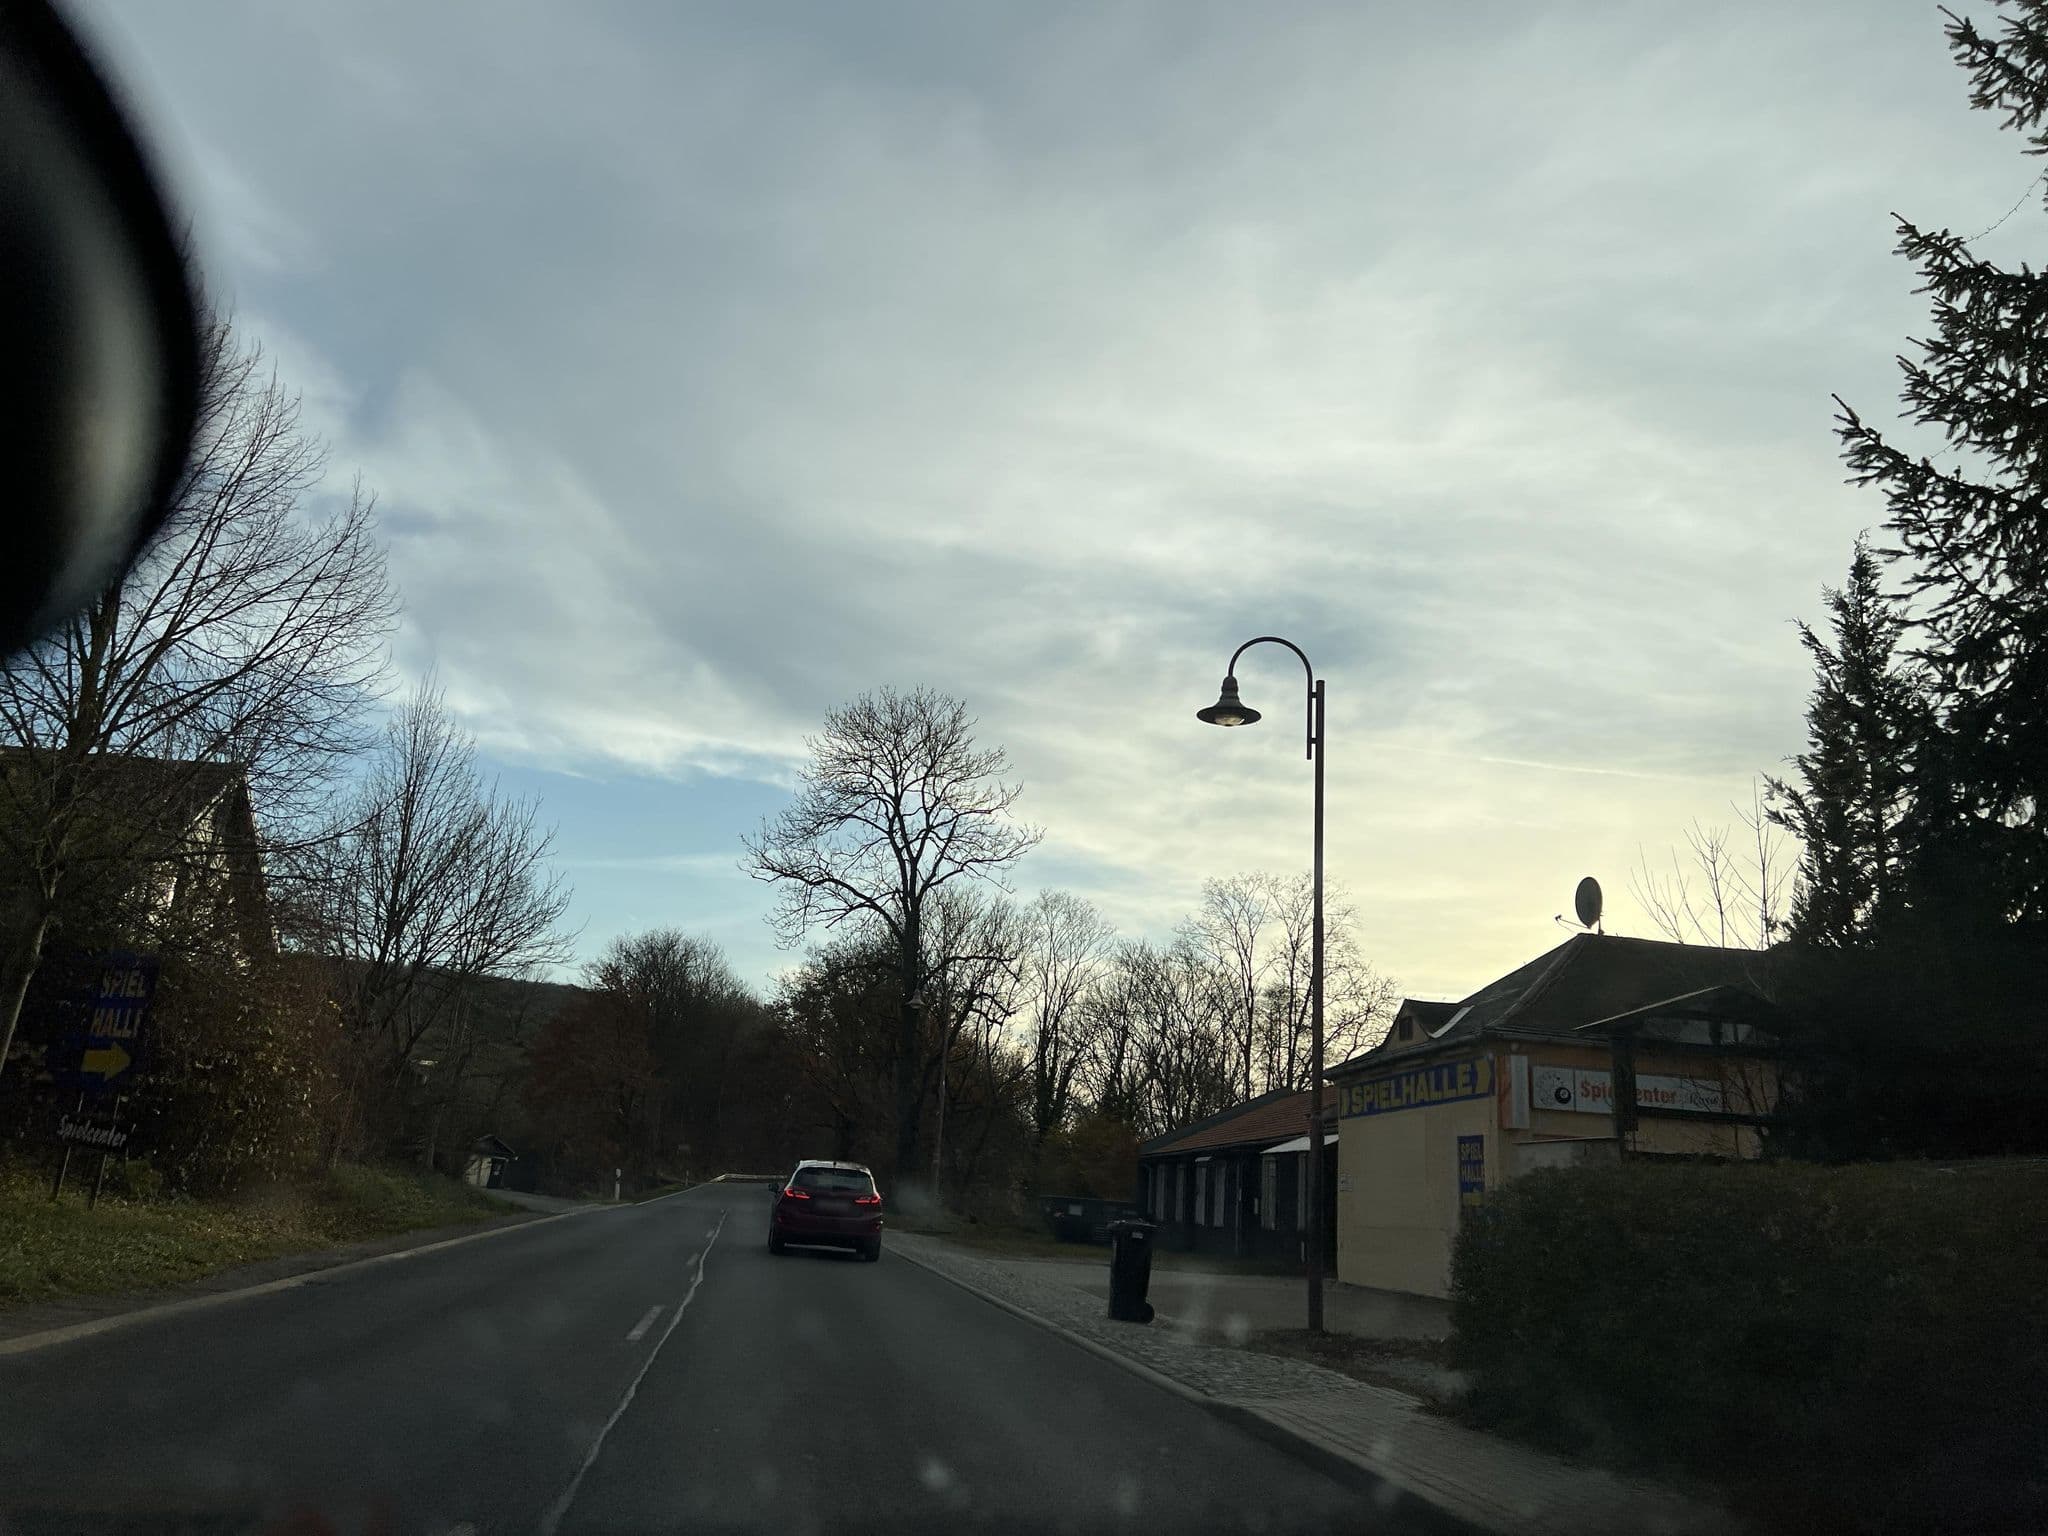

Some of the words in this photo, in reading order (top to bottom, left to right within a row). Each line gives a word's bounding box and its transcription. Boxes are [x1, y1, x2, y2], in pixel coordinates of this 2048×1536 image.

[101, 968, 147, 999] SPIEL
[1351, 1062, 1472, 1114] SPIELHALLE
[1460, 1142, 1483, 1161] SPIEL
